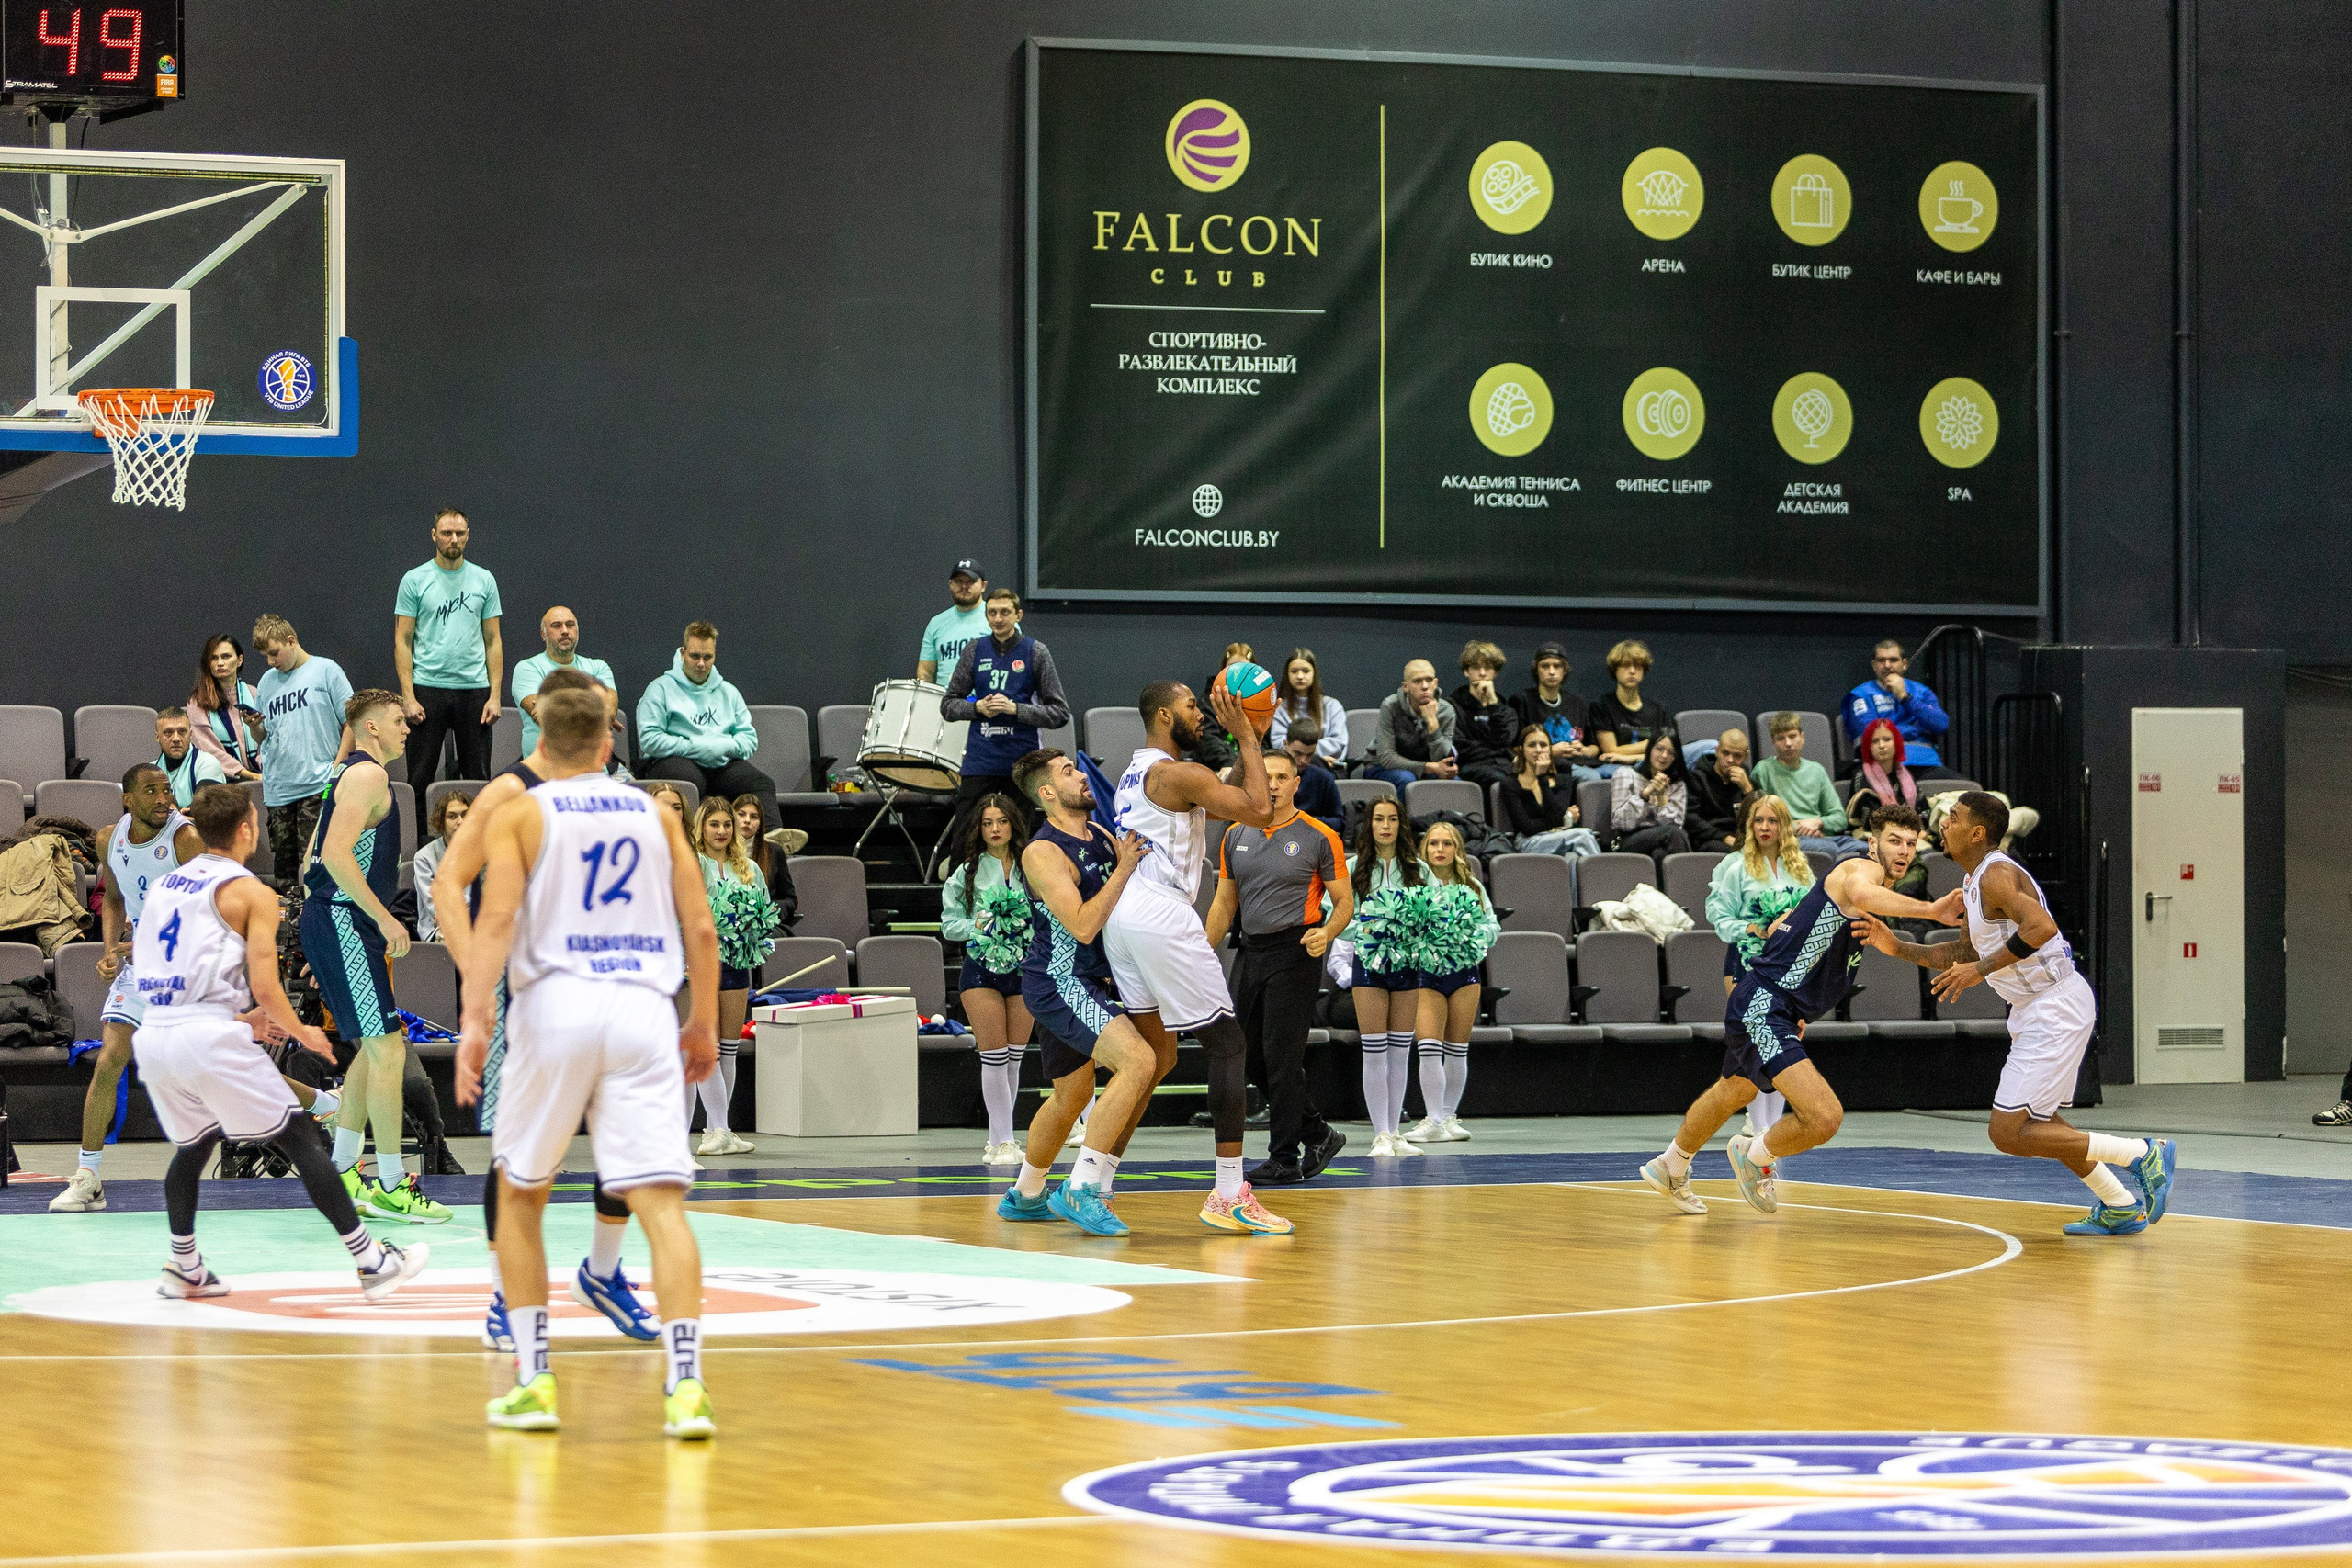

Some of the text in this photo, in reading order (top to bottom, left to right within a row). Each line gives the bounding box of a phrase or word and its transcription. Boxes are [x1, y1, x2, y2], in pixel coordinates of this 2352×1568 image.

[37, 7, 142, 82] 49
[5, 79, 59, 89] STRAMATEL
[1092, 210, 1323, 257] FALCON
[1469, 253, 1554, 269] БУТИК КИНО
[1641, 258, 1686, 273] АРЕНА
[1150, 267, 1266, 288] CLUB
[1772, 263, 1851, 279] БУТИК ЦЕНТР
[1916, 270, 2001, 286] КАФЕ И БАРЫ
[1148, 331, 1268, 351] СПОРТИВНО-
[262, 351, 311, 371] ЕДИНАЯ ЛИГА ВТБ
[1118, 351, 1297, 373] РАЗВЛЕКАТЕЛЬНЫЙ
[1156, 377, 1261, 396] КОМПЛЕКС
[264, 389, 314, 411] VTB UNITED LEAGUE
[1441, 474, 1581, 491] АКАДЕМИЯ ТЕННИСА
[1615, 478, 1712, 494] ФИТНЕС ЦЕНТР
[1783, 482, 1842, 497] ДЕТСКАЯ
[1473, 493, 1549, 508] И СКВОША
[1947, 487, 1972, 501] SPA
[1776, 500, 1849, 515] АКАДЕМИЯ
[1135, 528, 1280, 548] FALCONCLUB.BY
[989, 669, 1010, 691] 37
[580, 835, 641, 912] 12
[158, 906, 182, 964] 4
